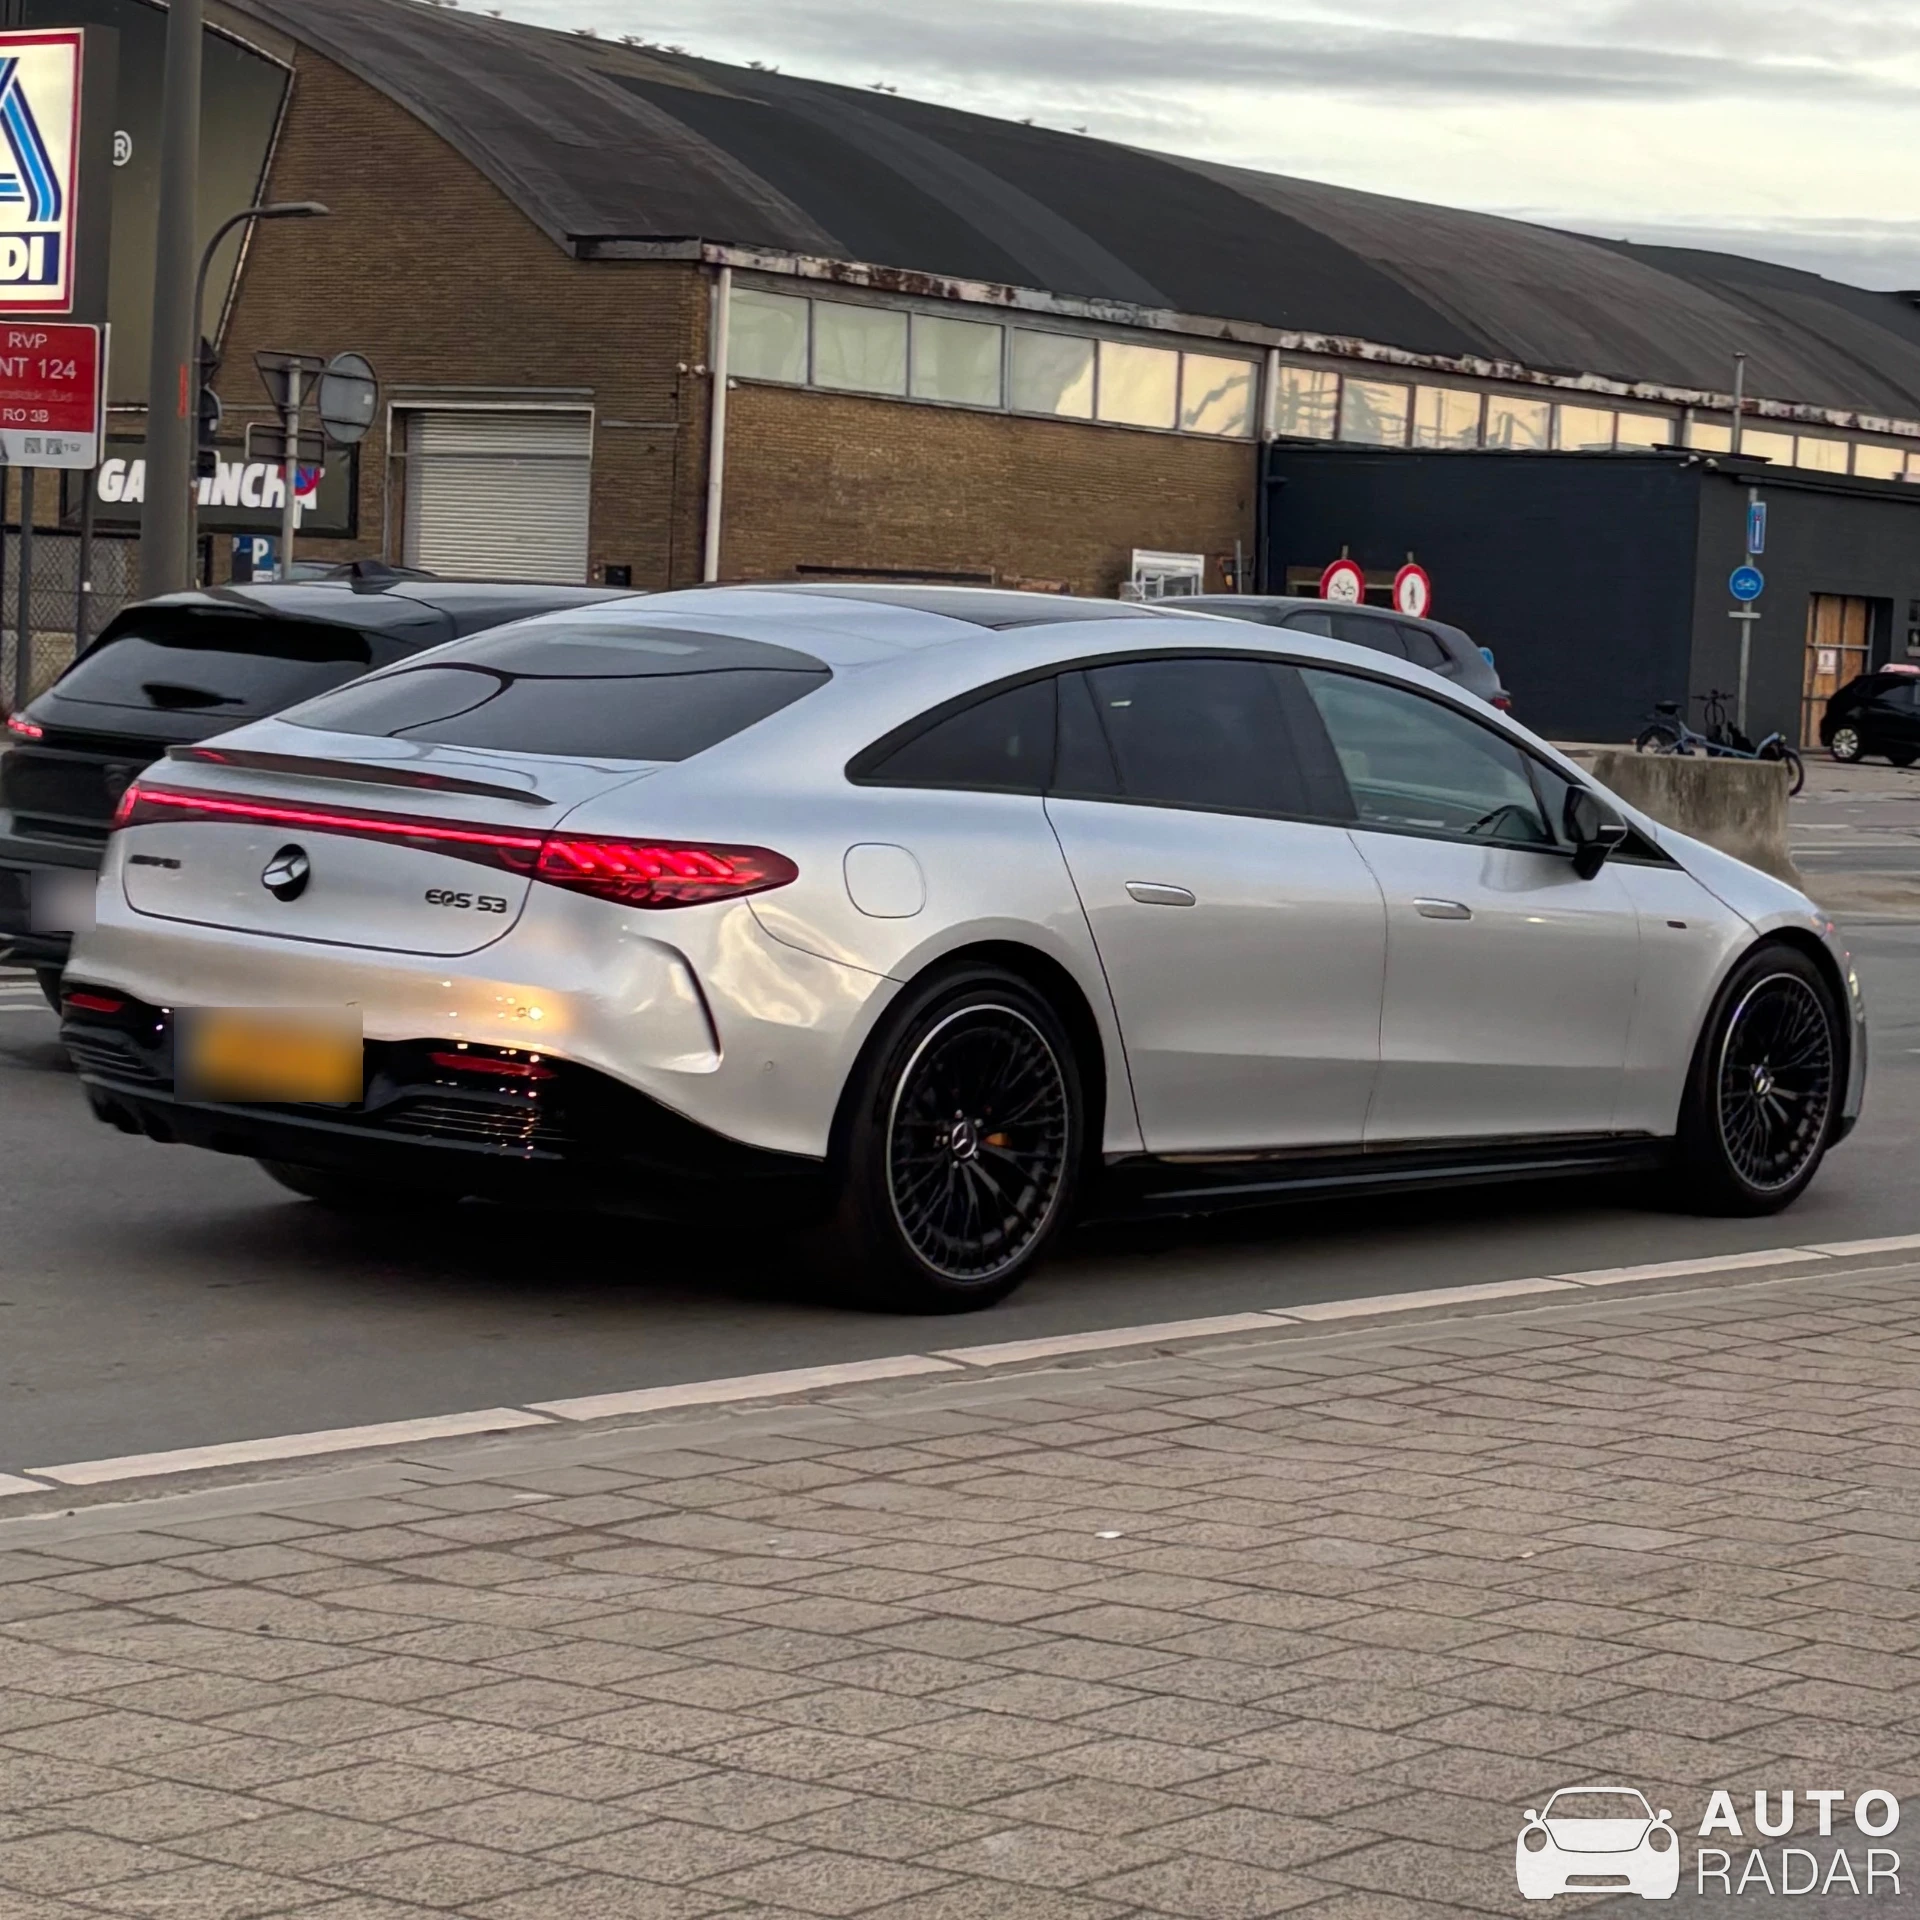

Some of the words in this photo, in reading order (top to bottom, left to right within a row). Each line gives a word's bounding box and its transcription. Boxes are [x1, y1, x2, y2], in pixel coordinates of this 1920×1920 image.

[8, 331, 48, 349] RVP
[38, 358, 77, 380] 124
[252, 538, 269, 565] P
[425, 888, 473, 909] EQS
[476, 895, 507, 914] 53
